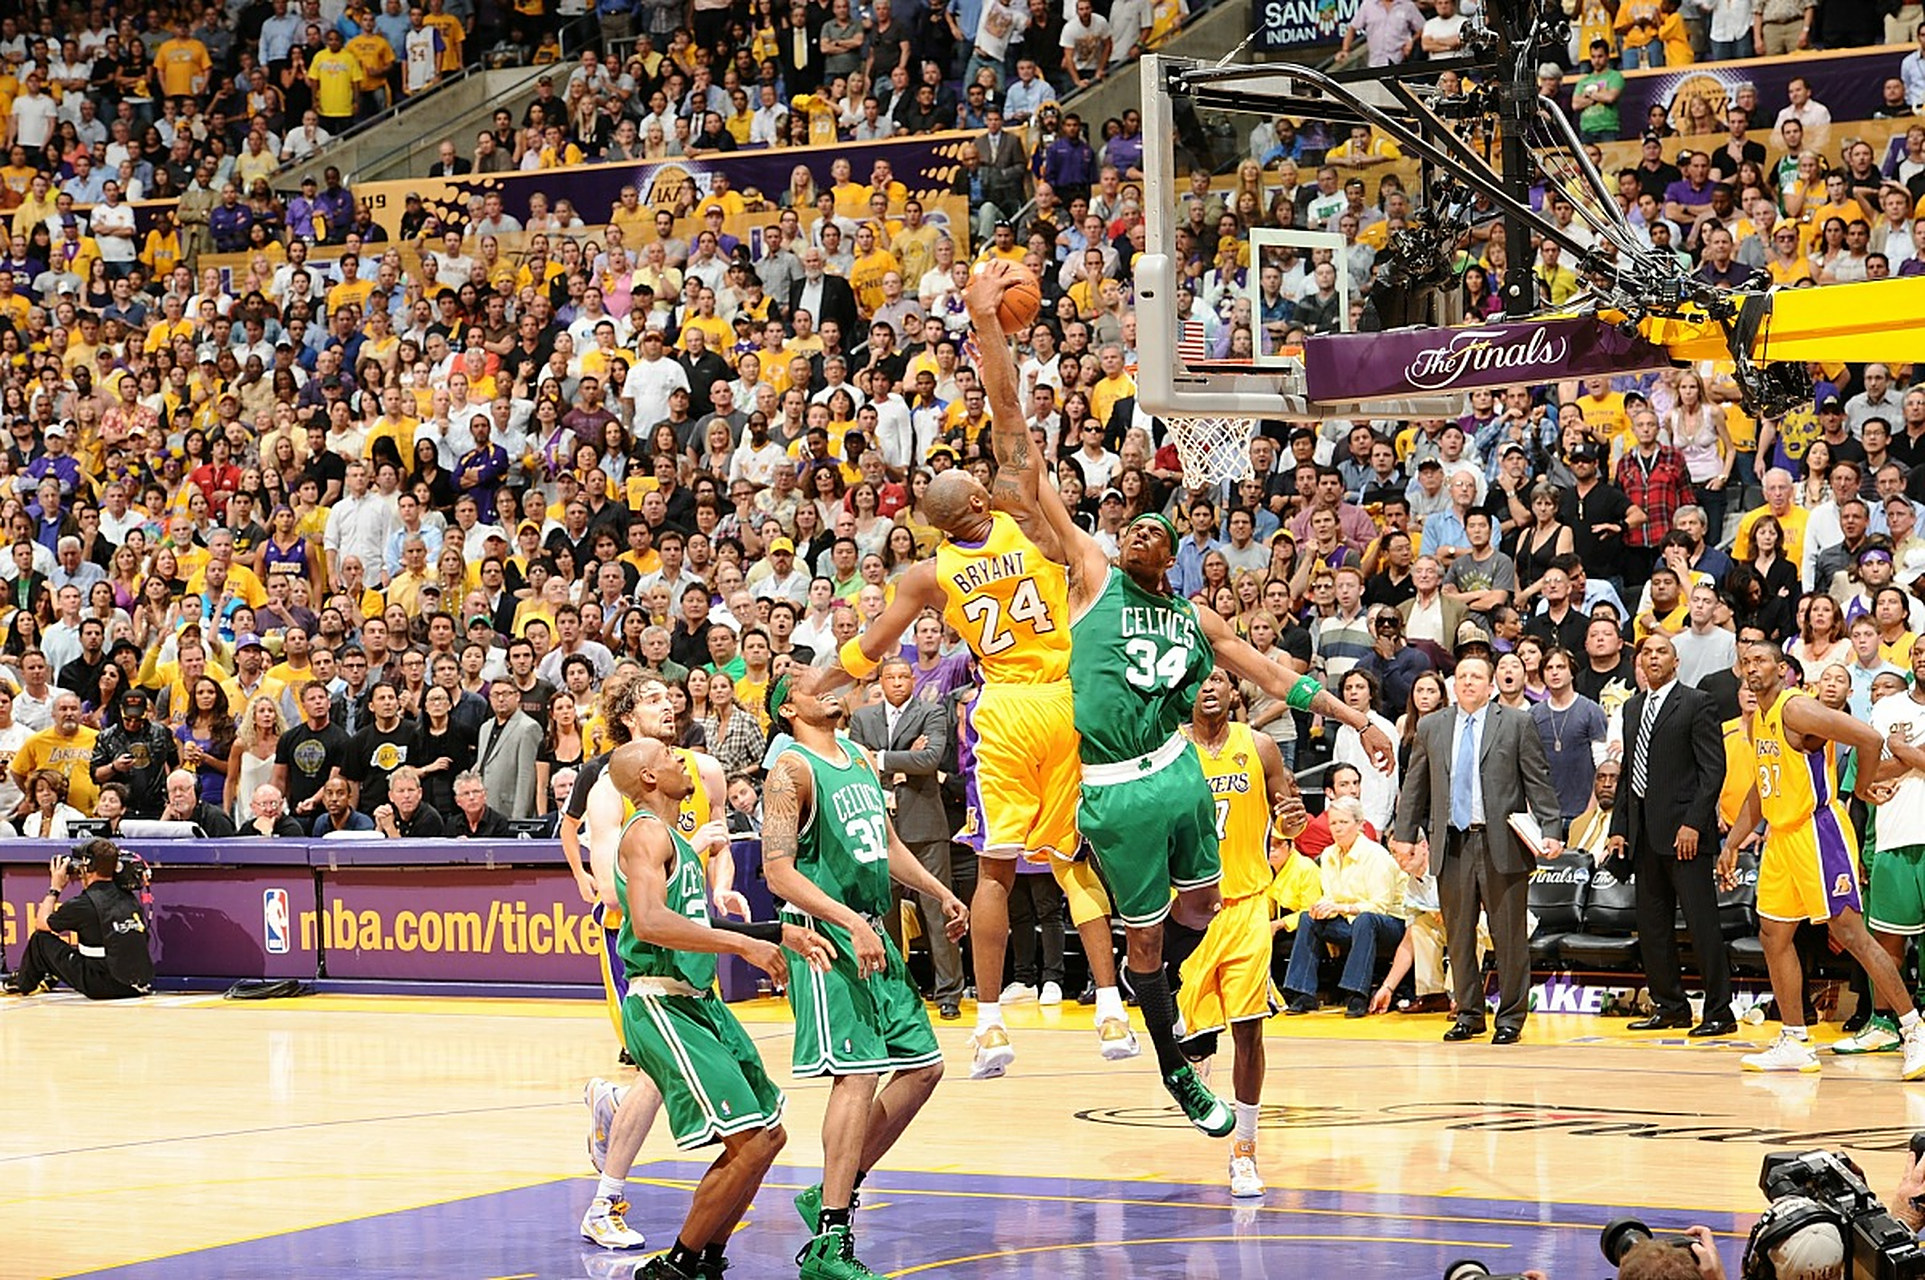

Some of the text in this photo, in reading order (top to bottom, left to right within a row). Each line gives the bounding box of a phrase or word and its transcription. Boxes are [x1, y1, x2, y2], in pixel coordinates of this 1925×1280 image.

[1265, 0, 1316, 28] SAN
[1266, 26, 1317, 45] INDIAN
[1405, 326, 1567, 389] The Finals
[953, 552, 1024, 594] BRYANT
[962, 576, 1056, 656] 24
[1121, 606, 1195, 650] CELTICS
[1125, 637, 1188, 689] 34
[48, 746, 93, 763] LAKERS
[832, 773, 884, 823] CELTICS
[1206, 773, 1249, 793] KERS
[1758, 763, 1781, 799] 37
[1528, 864, 1583, 885] Finals
[300, 899, 600, 955] nba.com/ticke
